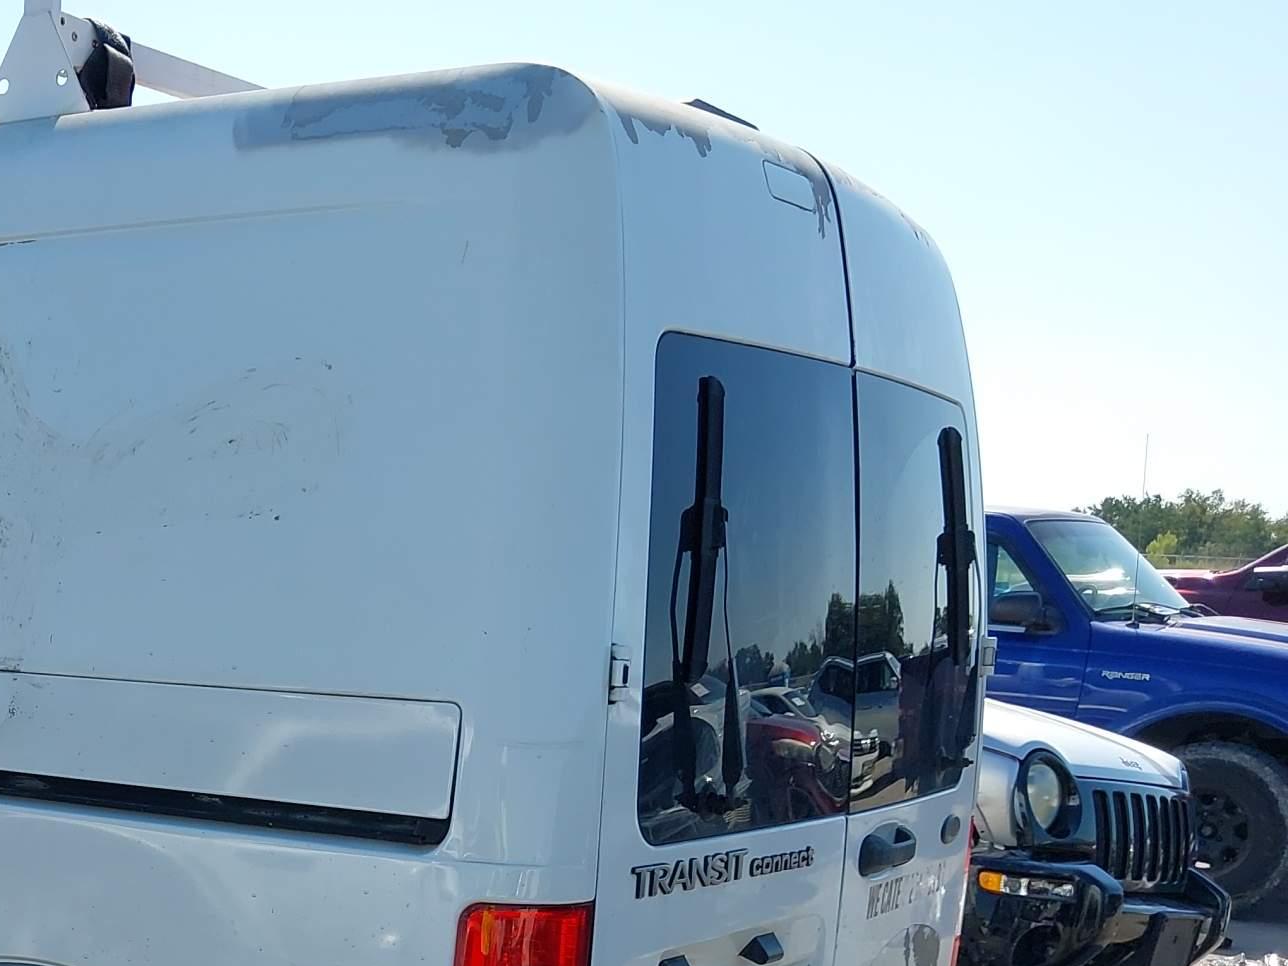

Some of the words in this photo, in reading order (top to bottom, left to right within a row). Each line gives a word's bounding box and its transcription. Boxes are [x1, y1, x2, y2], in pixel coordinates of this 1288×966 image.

[1101, 670, 1150, 681] RANGER
[630, 848, 749, 899] TRANSIT
[749, 846, 815, 877] connect
